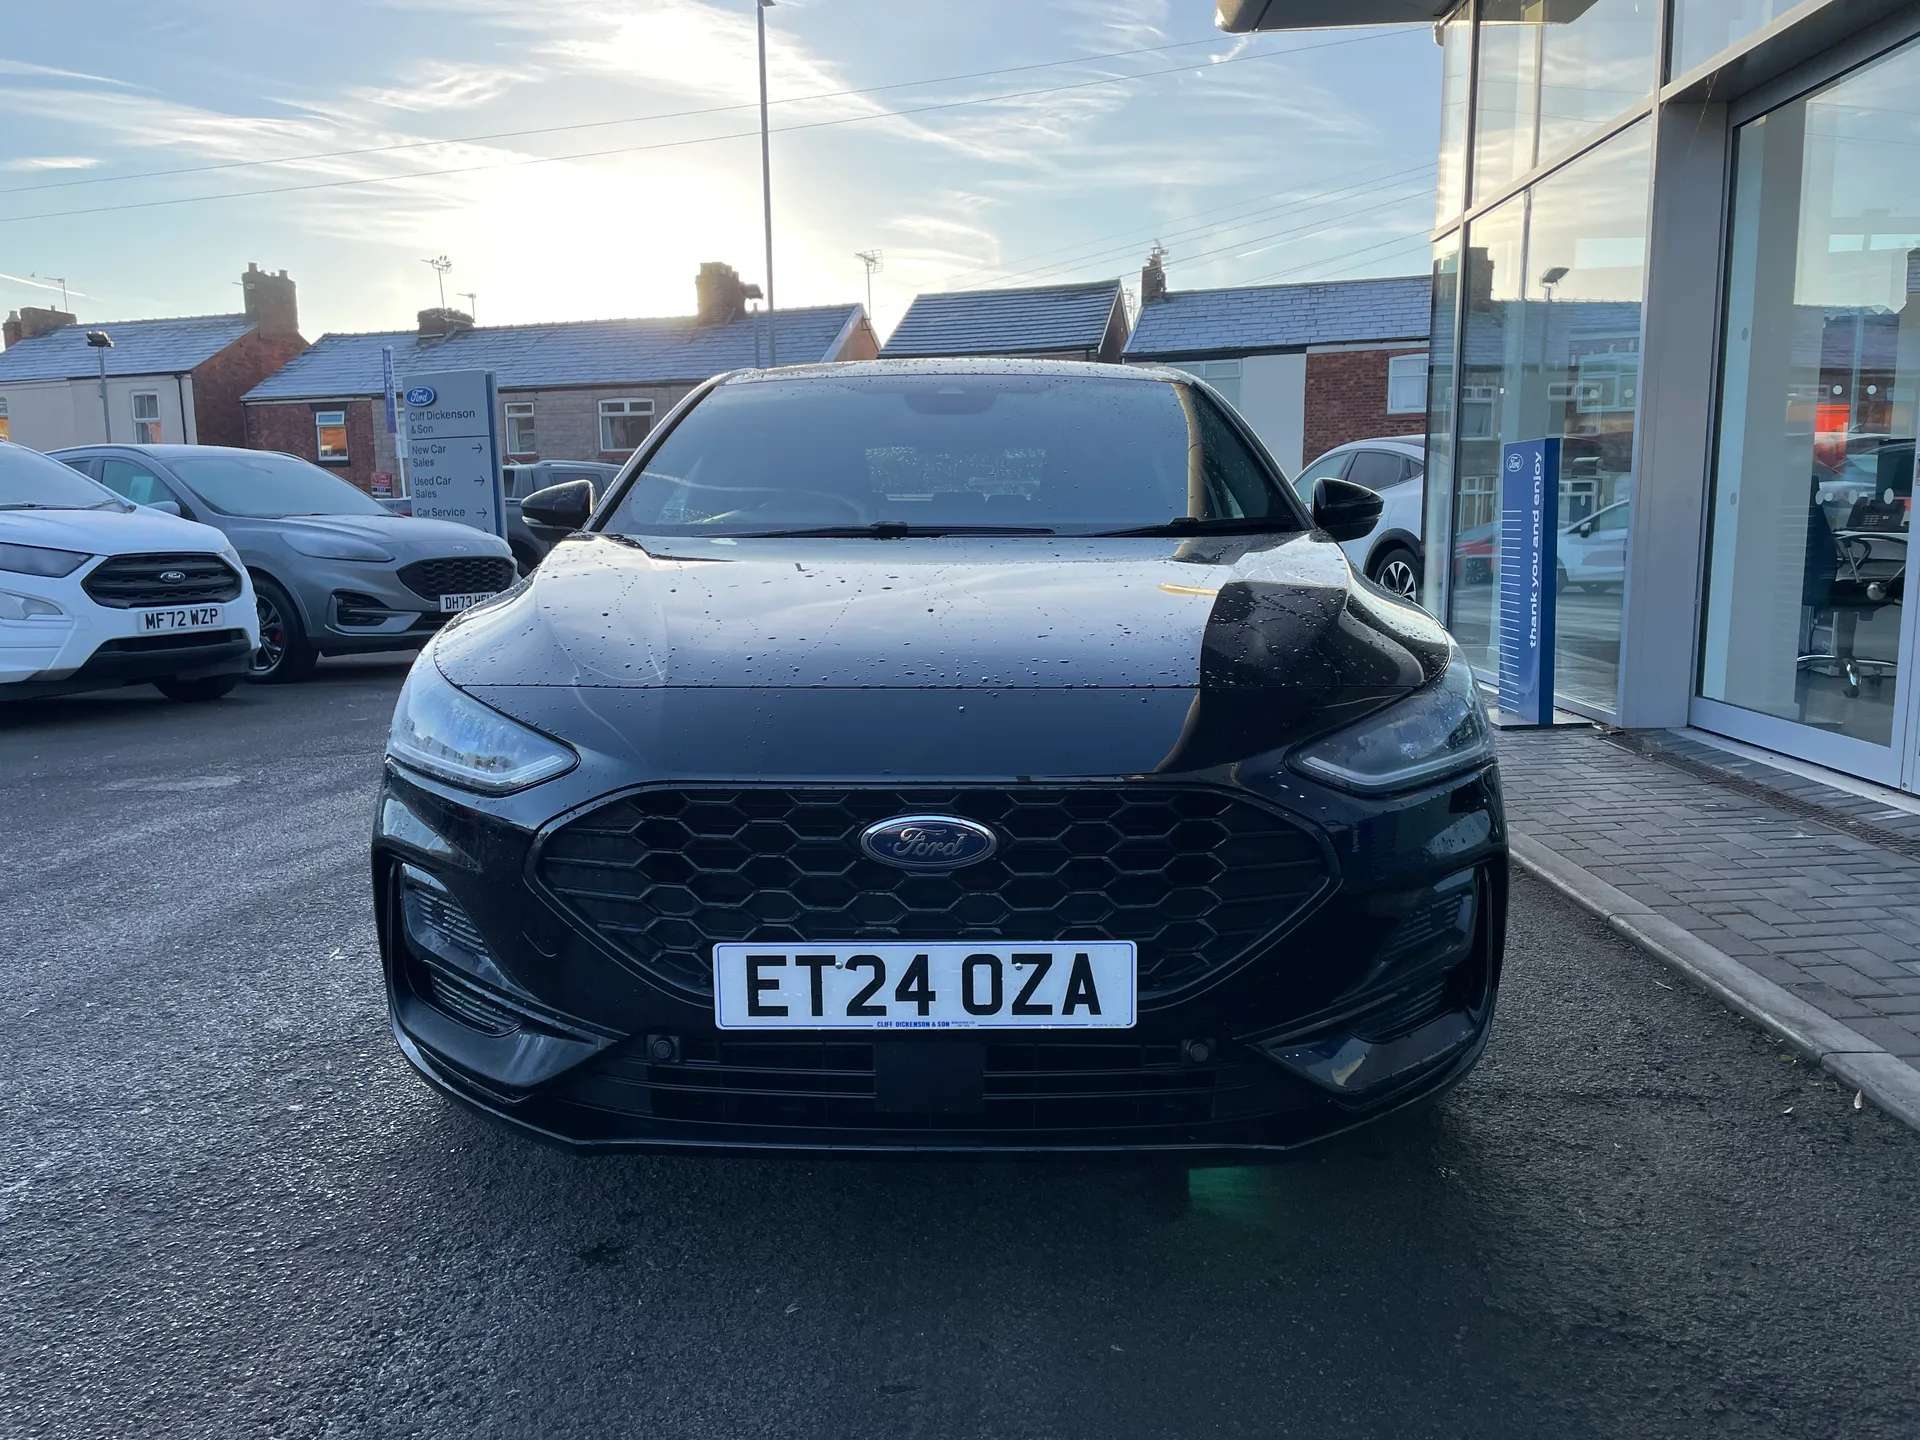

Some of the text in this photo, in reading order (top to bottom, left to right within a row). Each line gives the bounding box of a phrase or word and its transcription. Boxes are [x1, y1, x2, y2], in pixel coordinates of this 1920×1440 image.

[410, 389, 428, 402] Ford
[409, 409, 476, 422] Cliff Dickenson
[417, 424, 434, 434] Son
[412, 444, 446, 455] New Car
[413, 458, 434, 467] Sales
[414, 475, 452, 486] Used Car
[1533, 451, 1542, 506] enjoy
[415, 489, 437, 499] Sales
[416, 507, 466, 517] Car Service
[1532, 510, 1540, 548] and
[445, 595, 472, 610] DH73
[145, 608, 218, 630] MF72 WZP
[1529, 592, 1538, 649] thank
[892, 827, 968, 856] Ford
[746, 954, 936, 1017] ET24
